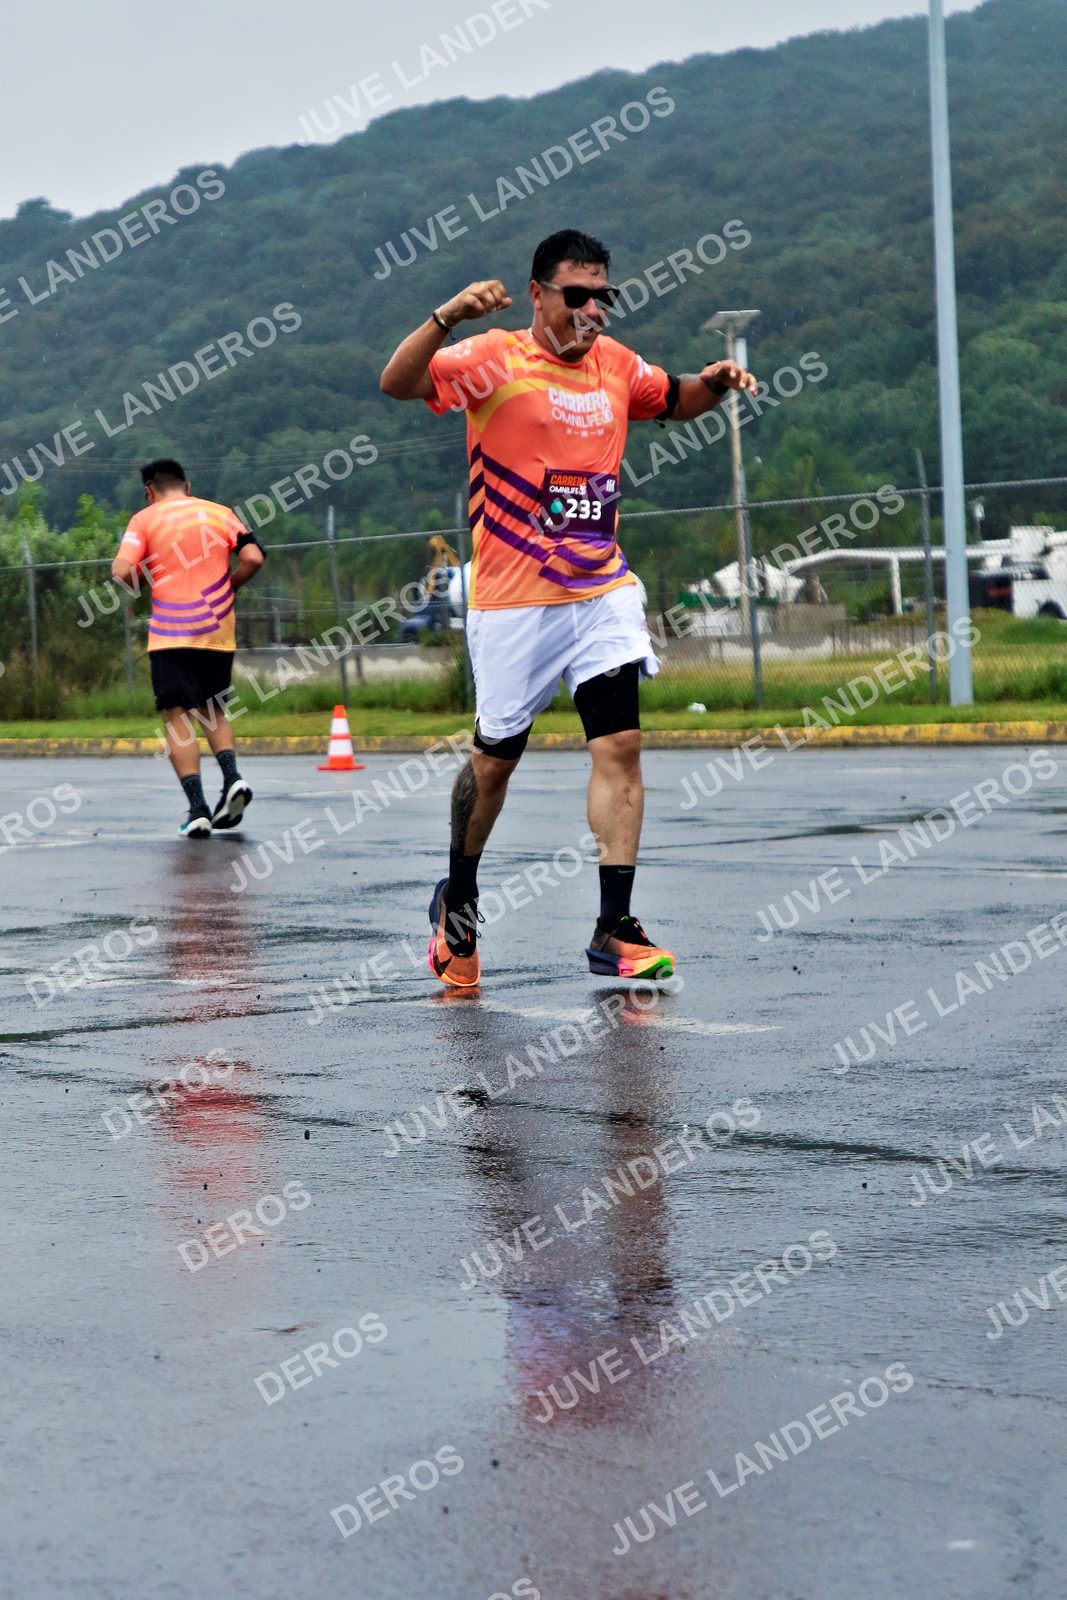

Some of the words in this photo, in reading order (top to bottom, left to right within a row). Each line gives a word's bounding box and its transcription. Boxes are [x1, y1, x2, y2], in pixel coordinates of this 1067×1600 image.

[548, 387, 612, 412] CARRERA
[550, 474, 588, 487] CARRERA
[565, 498, 602, 521] 233
